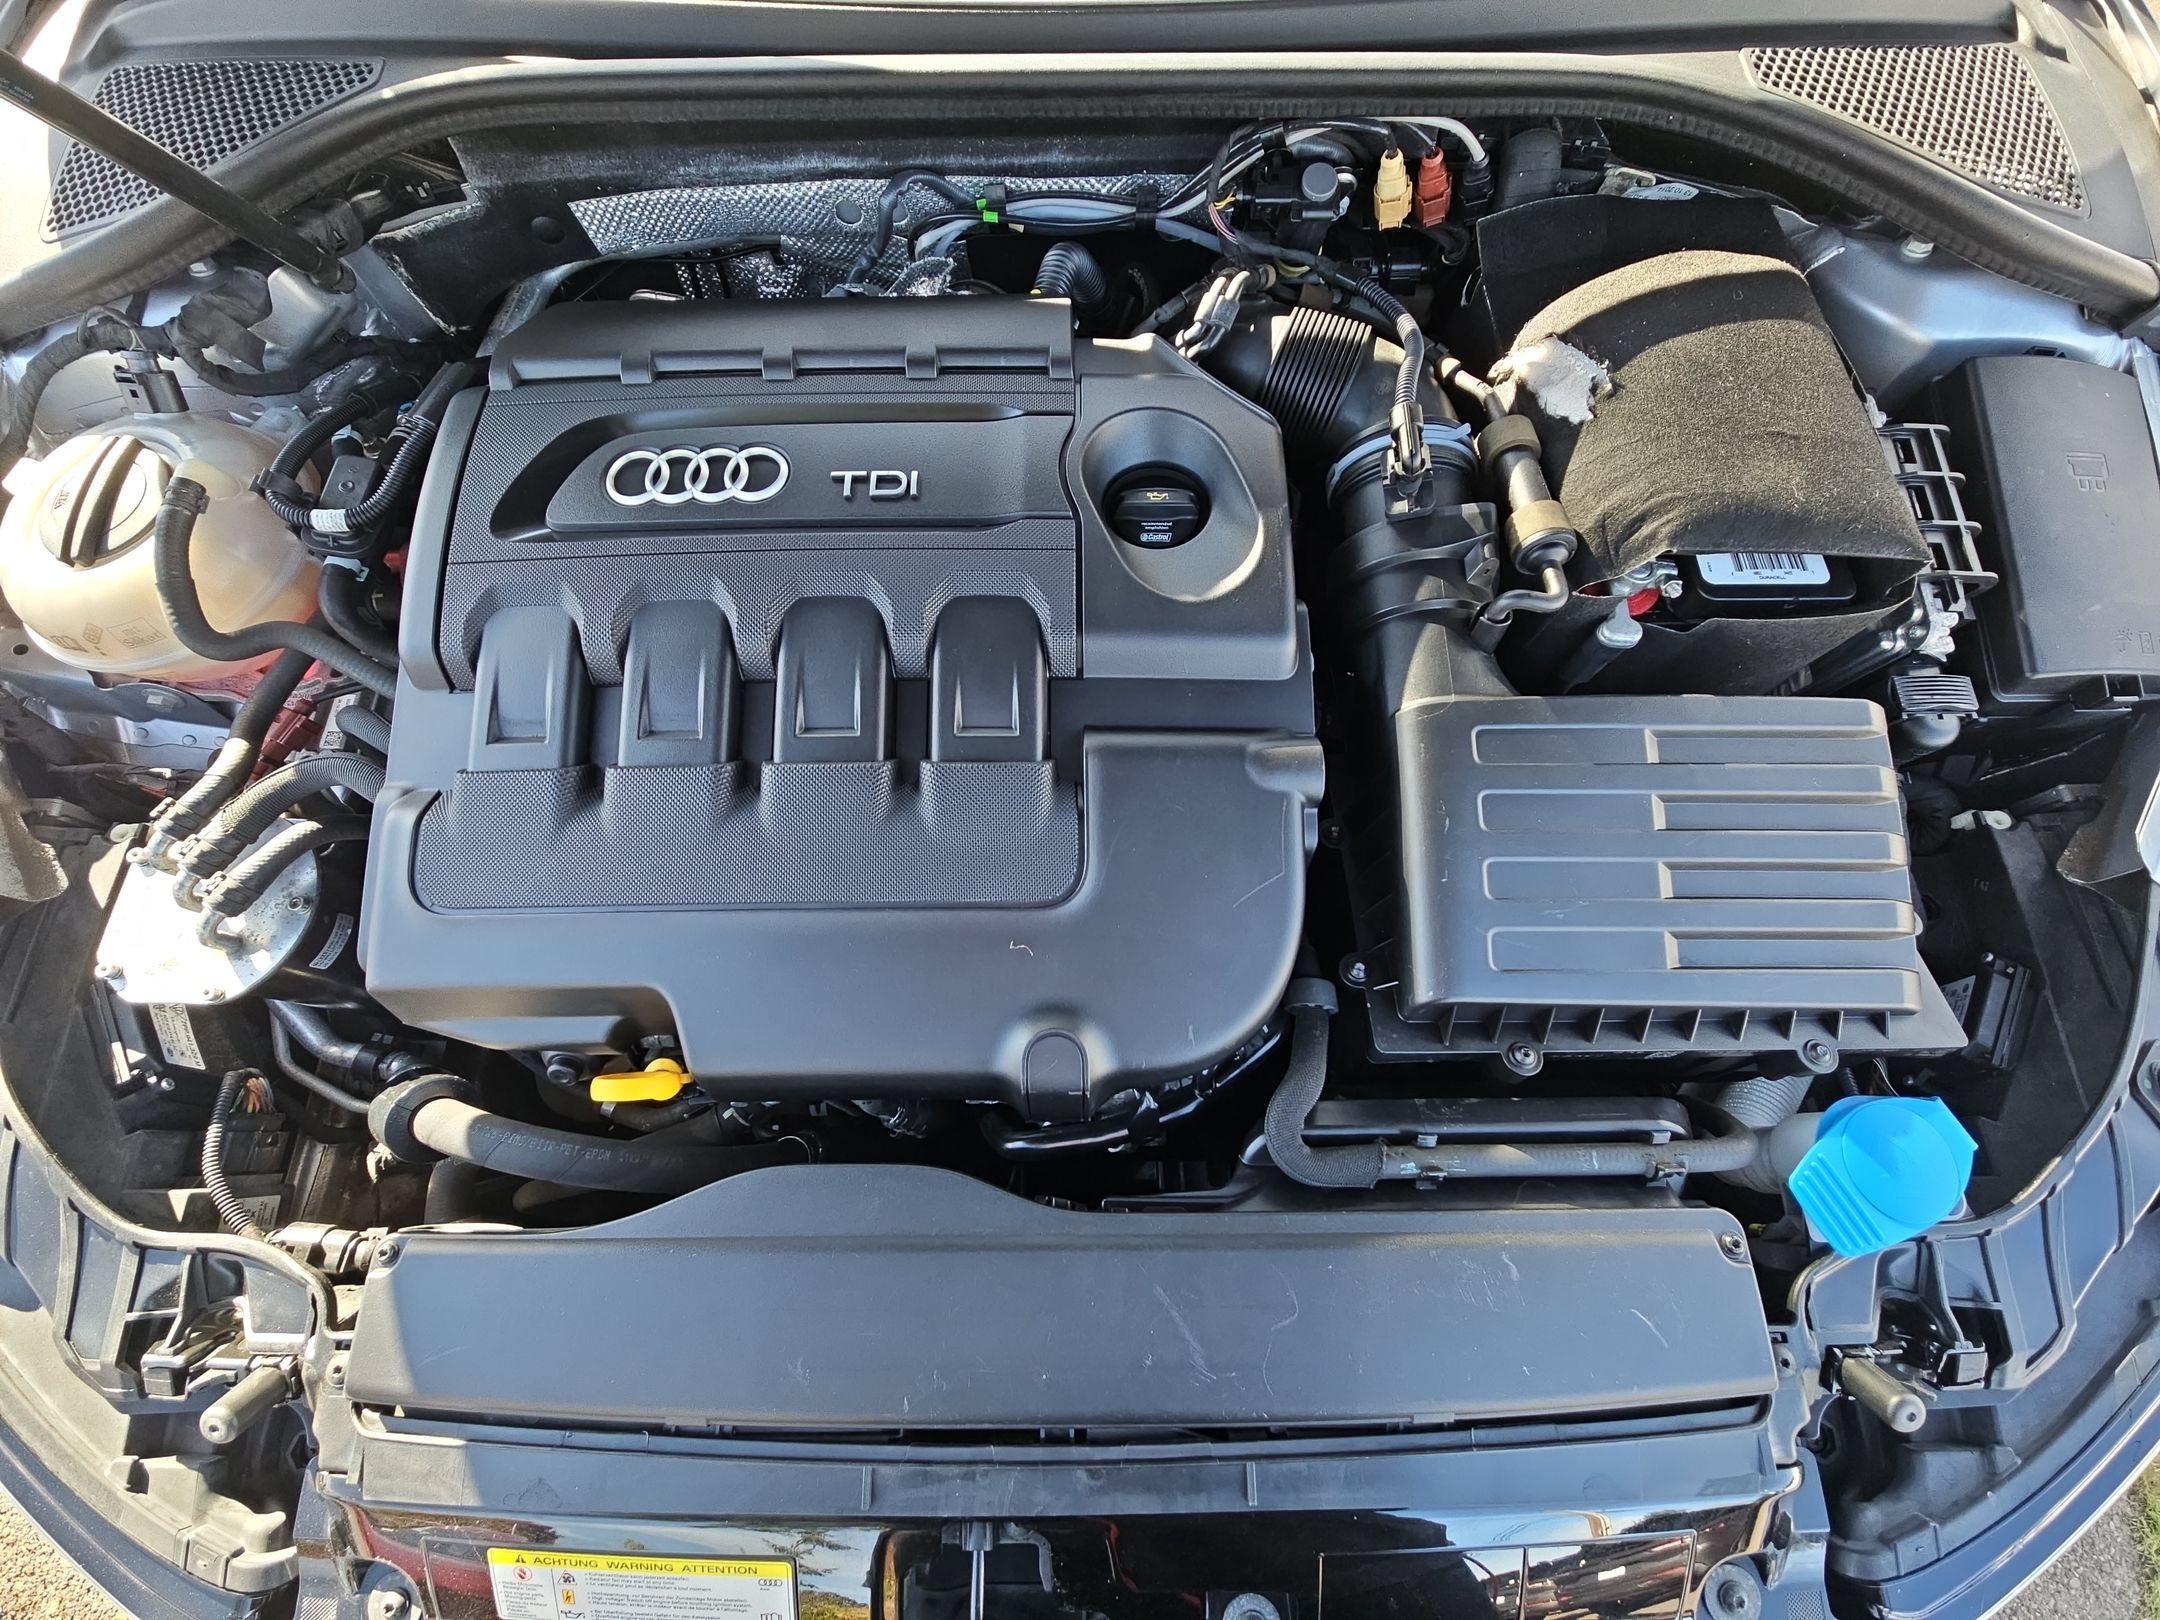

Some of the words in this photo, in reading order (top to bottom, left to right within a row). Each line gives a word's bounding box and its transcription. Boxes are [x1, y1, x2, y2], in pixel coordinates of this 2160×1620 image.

[830, 470, 919, 497] TDI
[1148, 533, 1170, 541] Castrol
[533, 1557, 599, 1569] ACHTUNG
[606, 1561, 674, 1572] WARNING
[682, 1564, 758, 1575] ATTENTION
